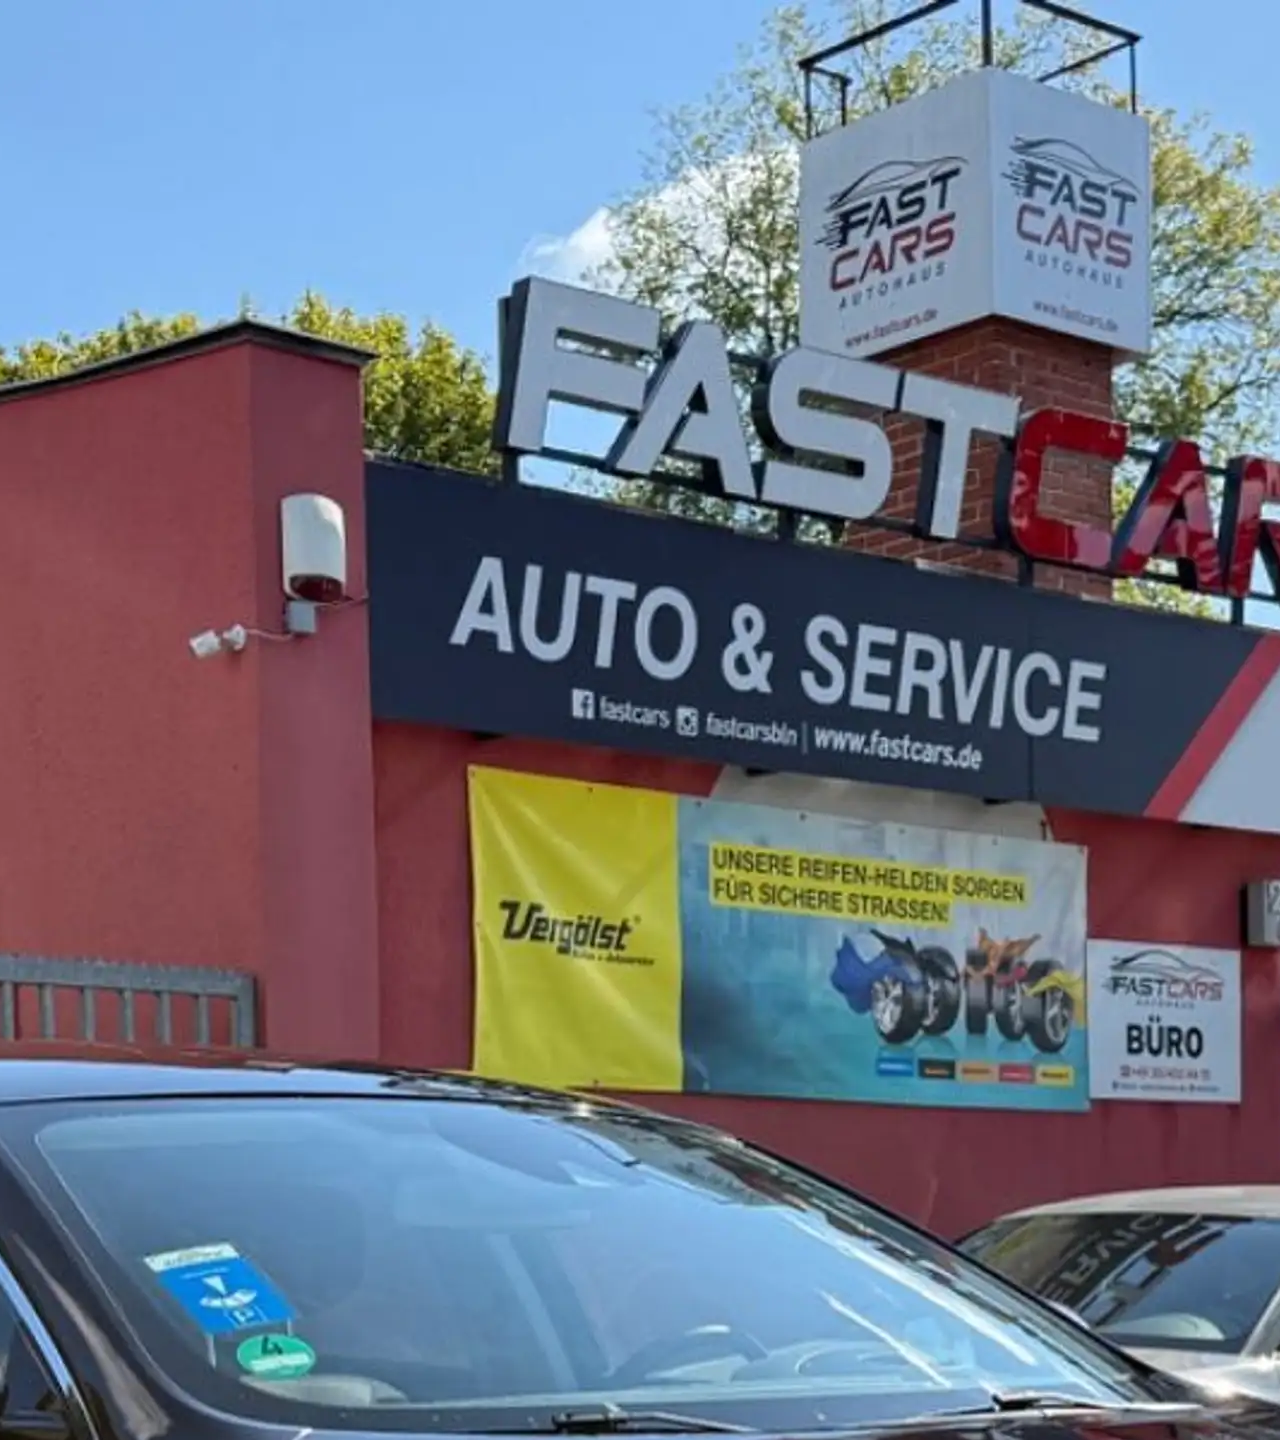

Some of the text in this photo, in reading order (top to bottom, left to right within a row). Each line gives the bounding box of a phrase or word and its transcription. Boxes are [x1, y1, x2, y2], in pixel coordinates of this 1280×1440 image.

[830, 168, 961, 249] FAST
[1018, 162, 1138, 227] FAST
[829, 213, 956, 292] CARS
[1016, 205, 1133, 270] CARS
[838, 262, 947, 310] AUTOHAUS
[1024, 250, 1125, 290] AUTOHAUS
[843, 307, 938, 350] www.fastcars.de
[449, 556, 1108, 742] AUTO & SERVICE
[600, 695, 671, 729] fastcars
[815, 725, 983, 770] www.fastcars.de
[713, 848, 1025, 901] UNSERE REIFEN-HELDEN SORGEN
[713, 875, 949, 922] FÜR SICHERE STRASSEN!
[499, 900, 632, 955] Vergölst
[1126, 1014, 1204, 1060] BÜRO
